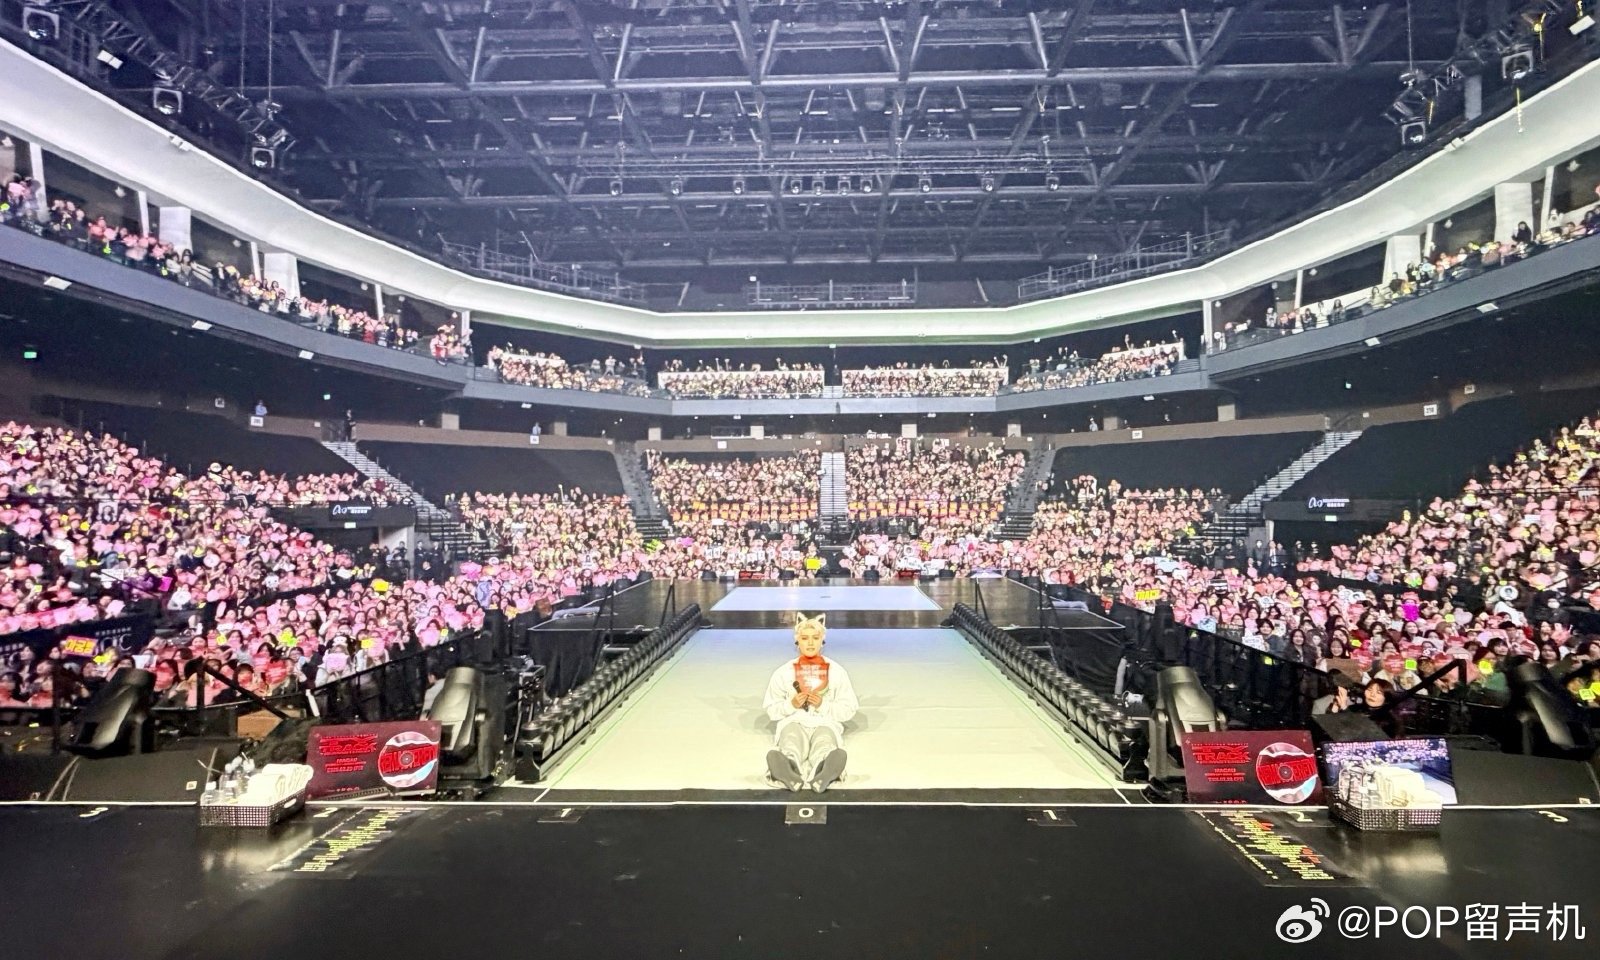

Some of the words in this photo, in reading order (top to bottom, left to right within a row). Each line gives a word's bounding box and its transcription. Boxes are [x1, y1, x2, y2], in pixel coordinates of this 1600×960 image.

[560, 807, 572, 818] 1
[798, 807, 814, 818] 0
[1042, 809, 1057, 820] 1
[1288, 810, 1313, 823] 2
